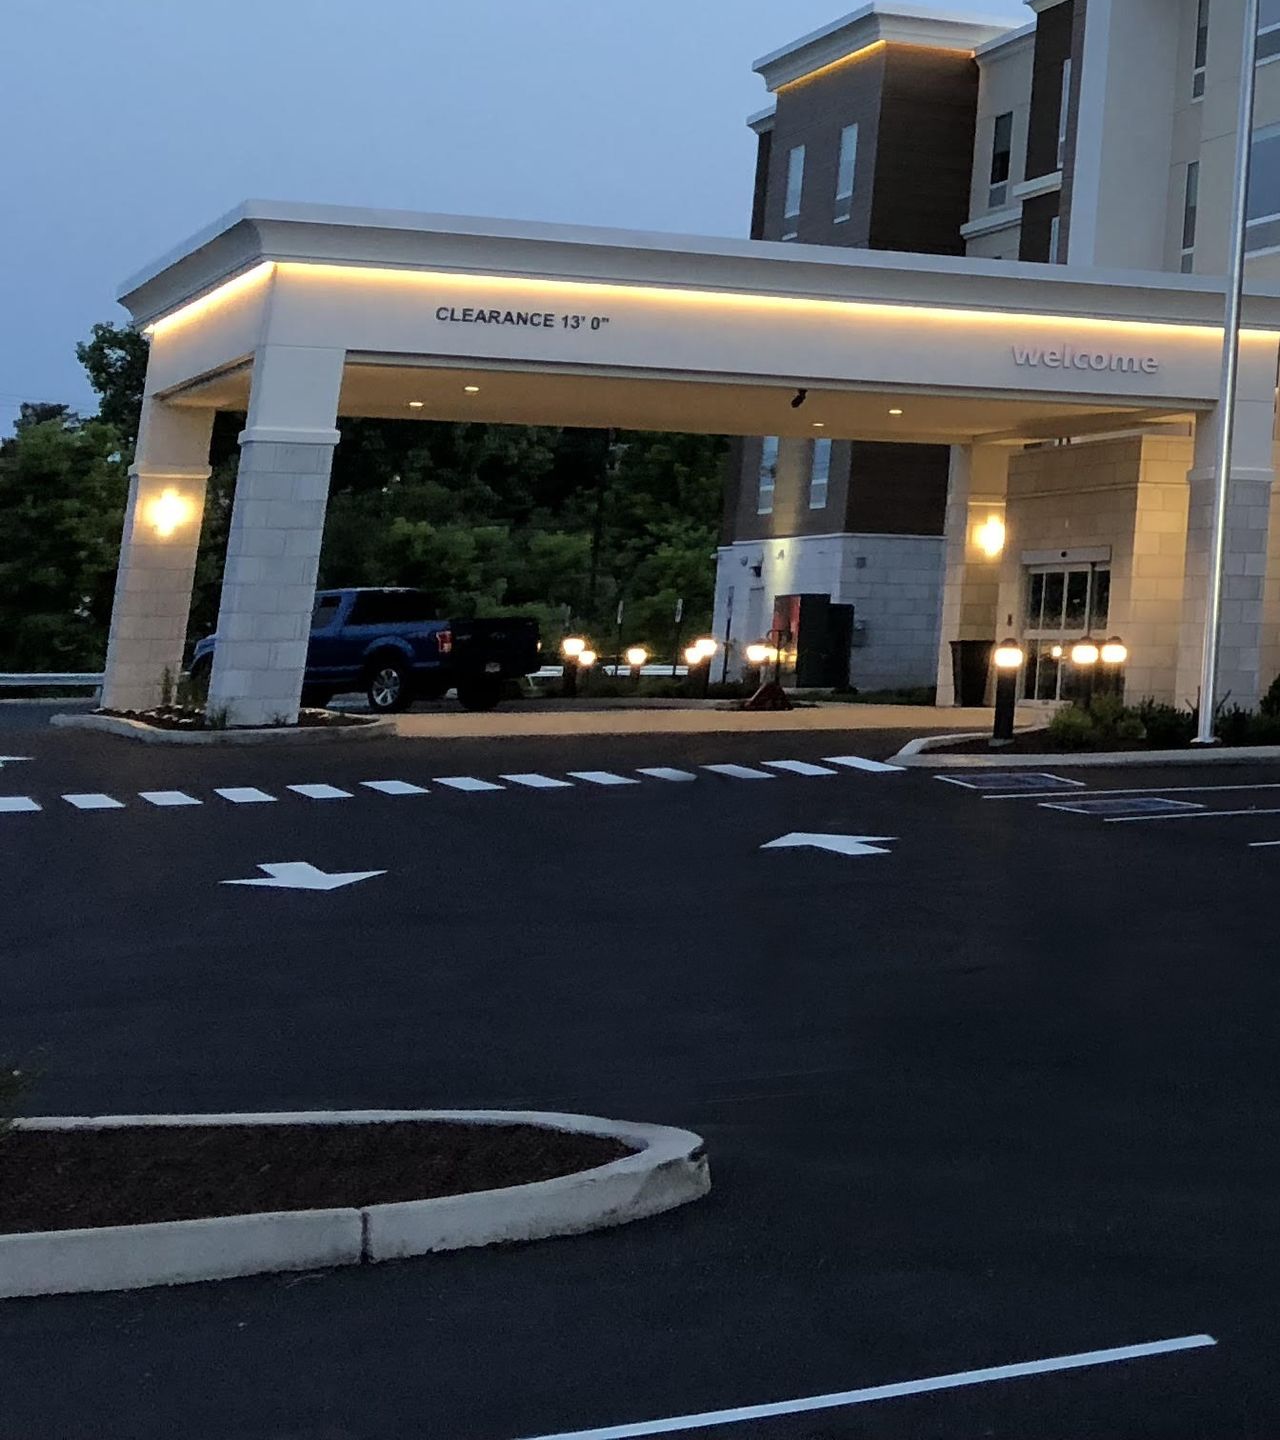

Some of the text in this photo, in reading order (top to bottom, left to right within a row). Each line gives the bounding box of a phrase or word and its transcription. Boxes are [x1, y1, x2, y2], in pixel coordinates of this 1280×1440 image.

[435, 306, 555, 328] CLEARANCE
[562, 314, 586, 330] 13'
[1012, 343, 1160, 374] welcome
